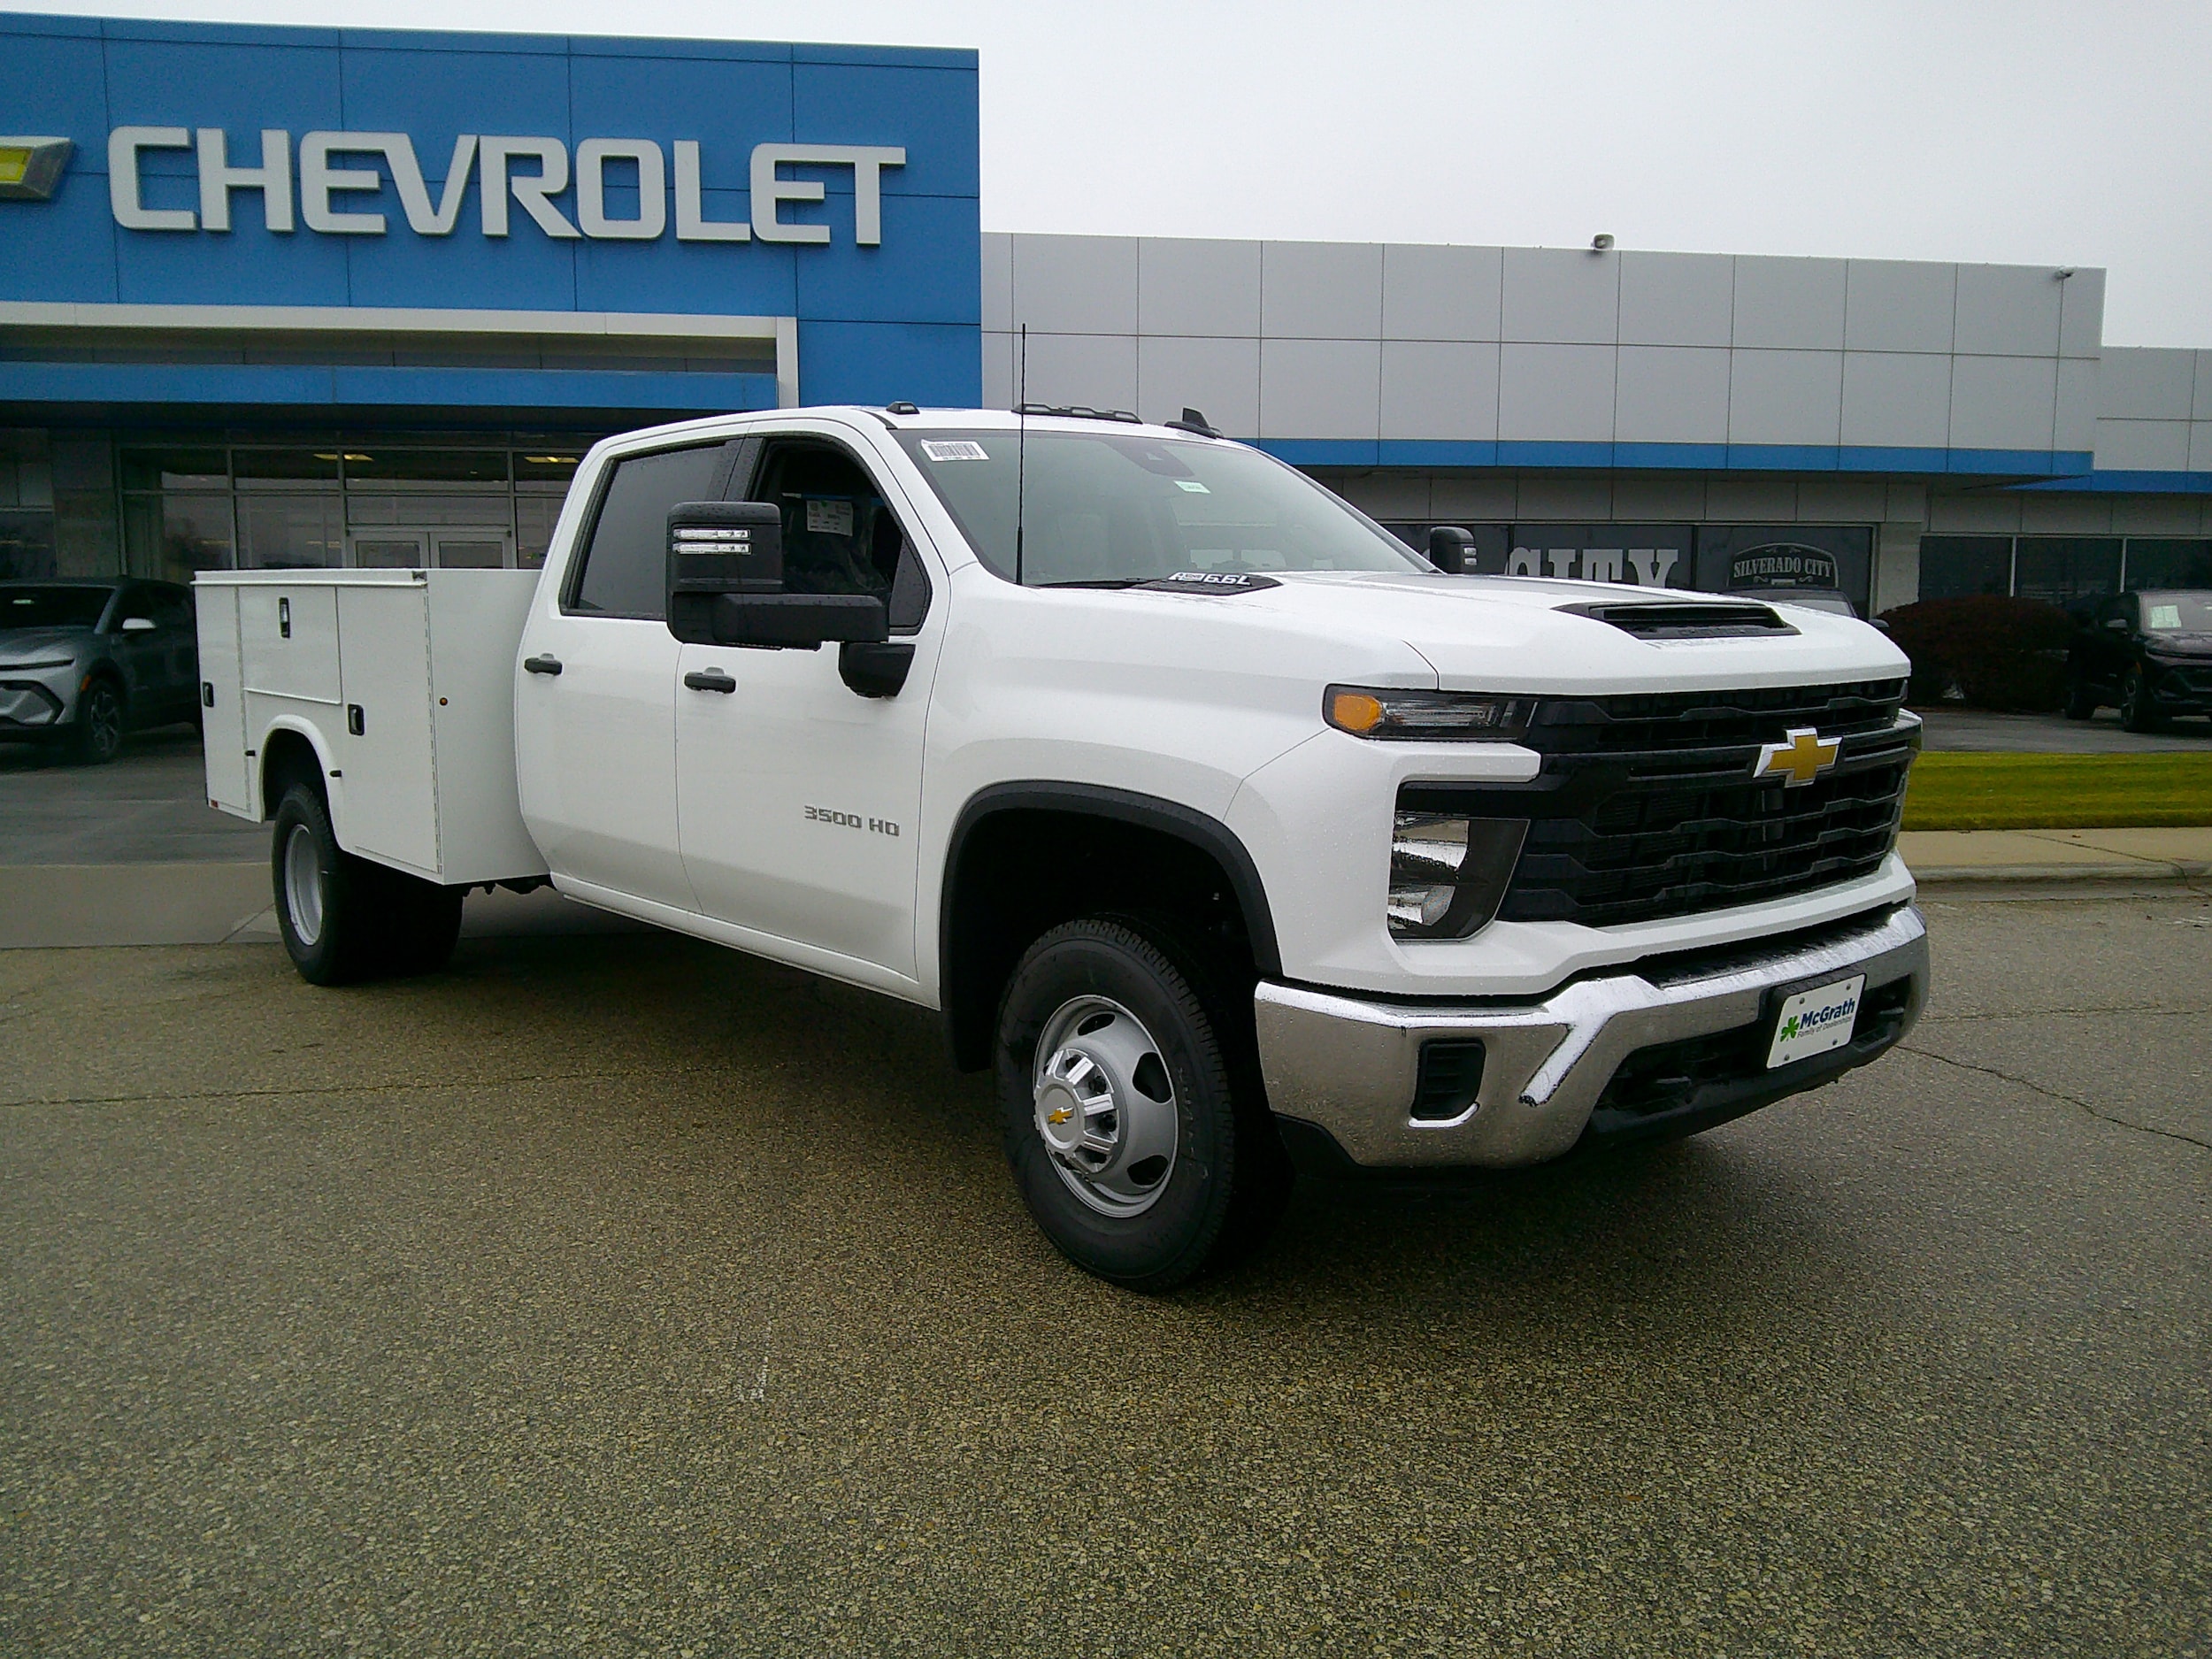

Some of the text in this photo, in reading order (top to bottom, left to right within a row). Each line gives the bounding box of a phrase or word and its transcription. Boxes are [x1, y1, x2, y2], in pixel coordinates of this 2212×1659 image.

[109, 125, 907, 246] CHEVROLET
[1202, 573, 1251, 586] 6.6L
[1733, 557, 1832, 578] SILVERADO CITY
[803, 804, 900, 837] 3500 HD
[1800, 997, 1855, 1029] McGrath
